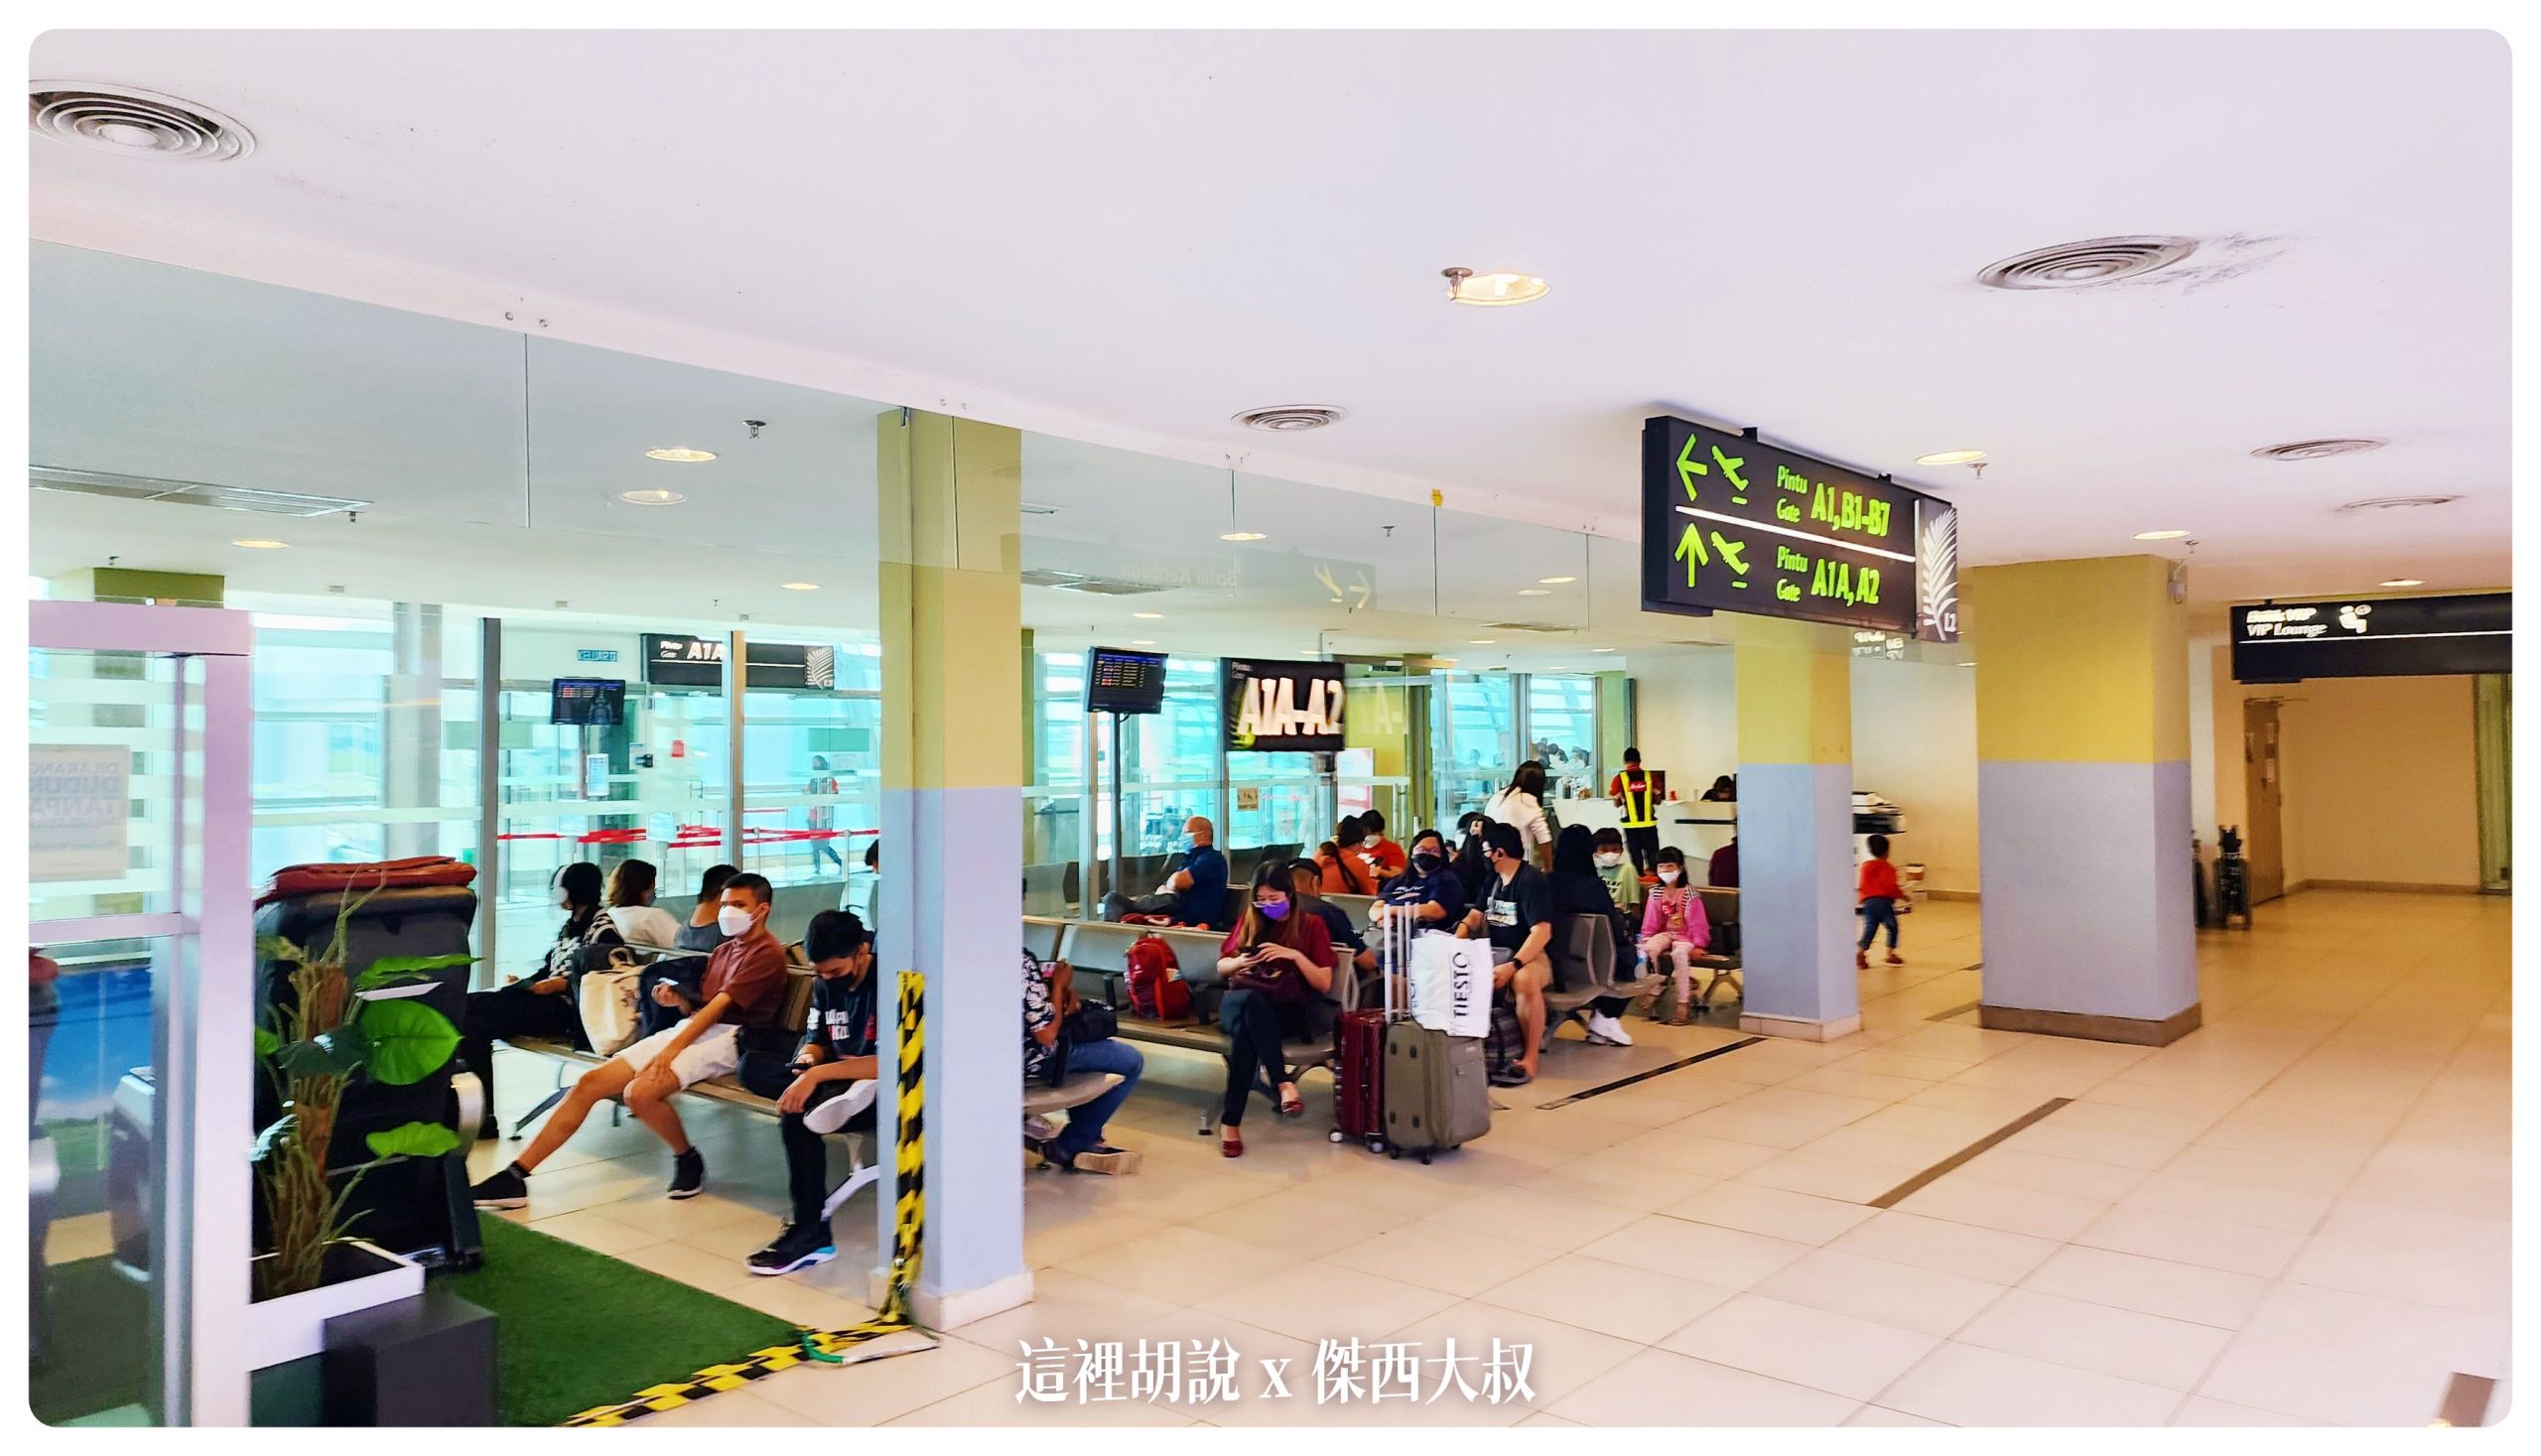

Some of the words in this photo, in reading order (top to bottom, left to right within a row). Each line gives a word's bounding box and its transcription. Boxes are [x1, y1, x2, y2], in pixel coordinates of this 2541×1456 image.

[1776, 464, 1808, 494] Pintu
[1776, 497, 1802, 523] Gate
[1809, 482, 1892, 537] A1,B1-B7
[1776, 545, 1809, 573] Pintu
[1776, 578, 1802, 602] Gate
[2246, 622, 2274, 637] VIP
[2273, 622, 2329, 638] Lounge
[686, 641, 728, 661] A1A
[1237, 677, 1345, 736] A1A-A2
